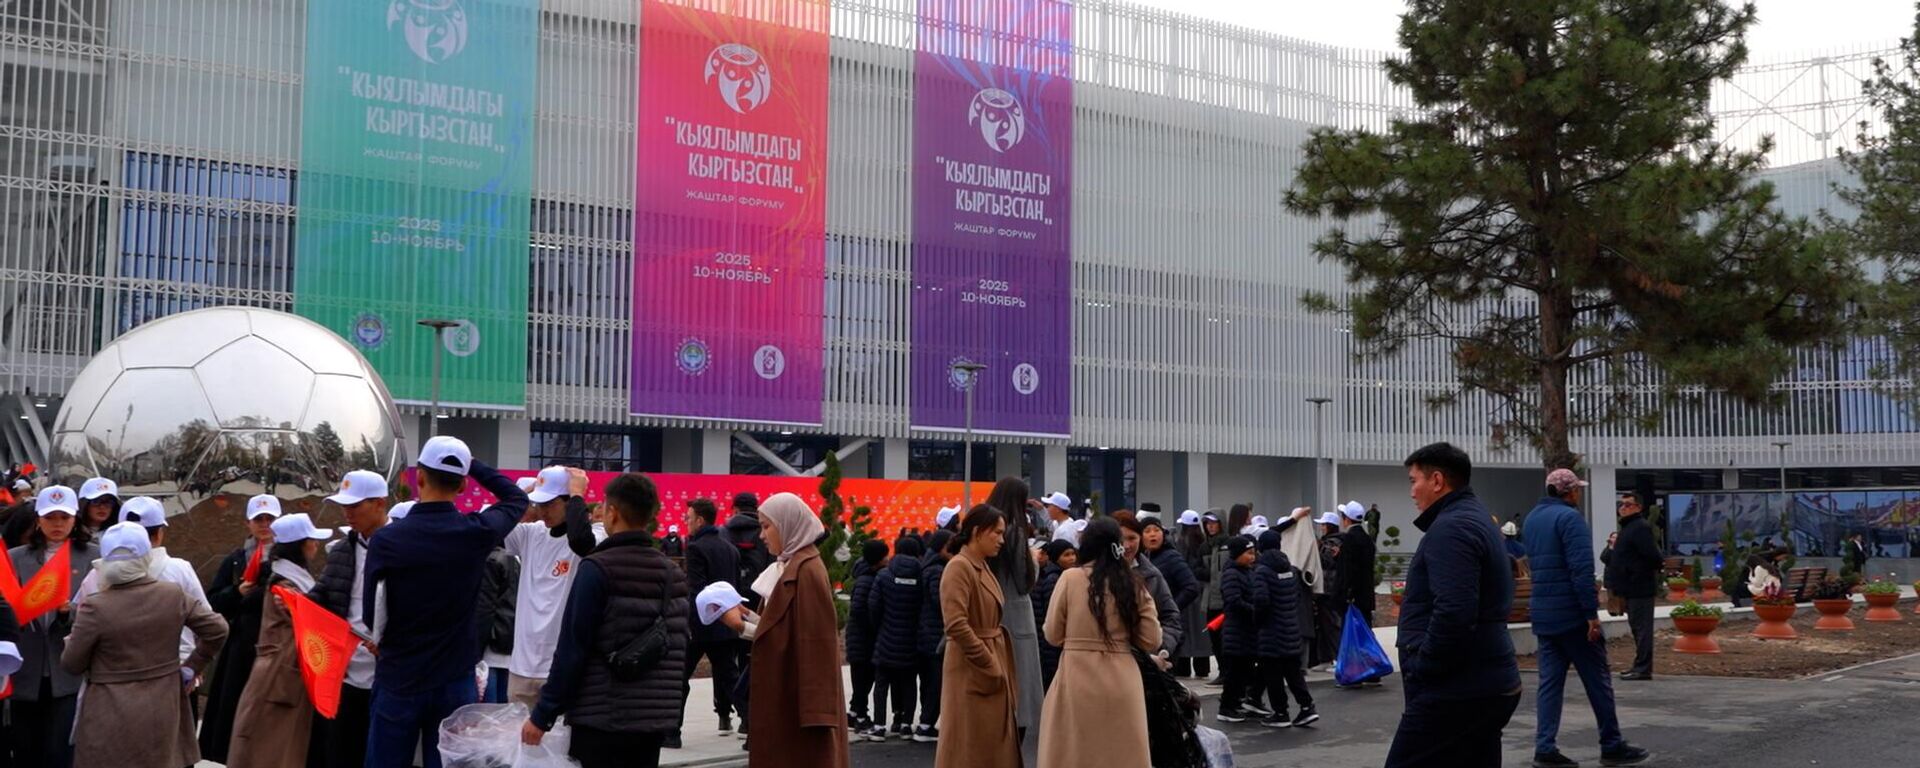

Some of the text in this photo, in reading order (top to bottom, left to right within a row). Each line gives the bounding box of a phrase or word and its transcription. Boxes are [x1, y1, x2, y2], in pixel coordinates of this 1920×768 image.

[363, 147, 482, 170] ЖАШТАР ФОРУМУ
[686, 189, 785, 210] ЖАШТАР ФОРУМУ
[398, 216, 441, 231] 2025
[954, 222, 1037, 240] ЖАШТАР ФОРУМУ
[371, 230, 465, 252] 10-НОЯБРЬ
[715, 252, 750, 266] 2025
[693, 265, 771, 284] 10-НОЯБРЬ
[979, 279, 1009, 292] 2025
[961, 291, 1026, 308] 10-НОЯБРЬ
